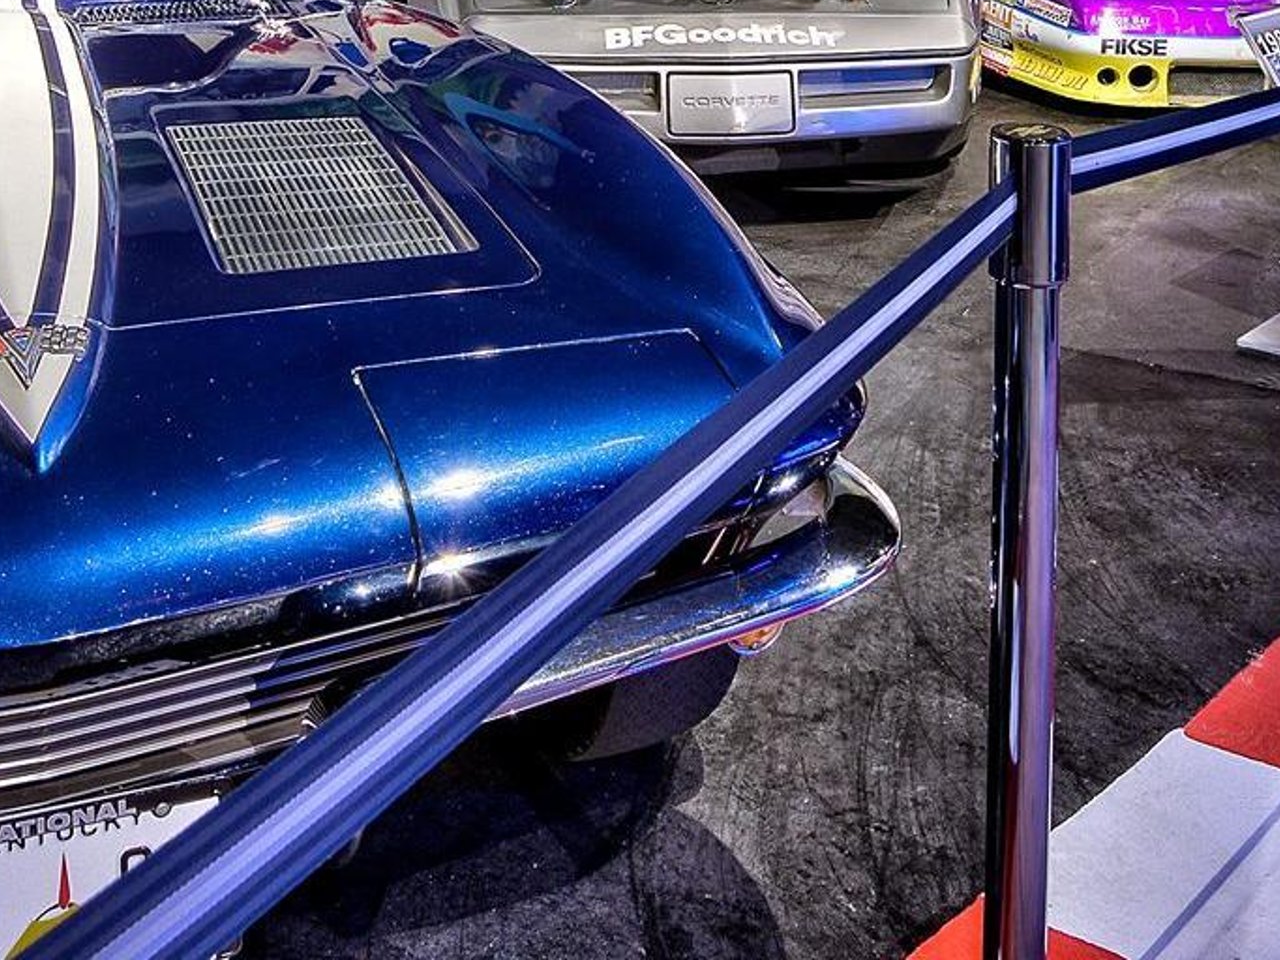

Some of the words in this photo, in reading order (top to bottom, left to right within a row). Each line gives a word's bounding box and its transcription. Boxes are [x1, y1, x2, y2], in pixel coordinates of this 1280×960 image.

[604, 23, 838, 50] BFGoodrich
[1101, 38, 1168, 56] FIKSE
[682, 94, 780, 108] CORVETTE
